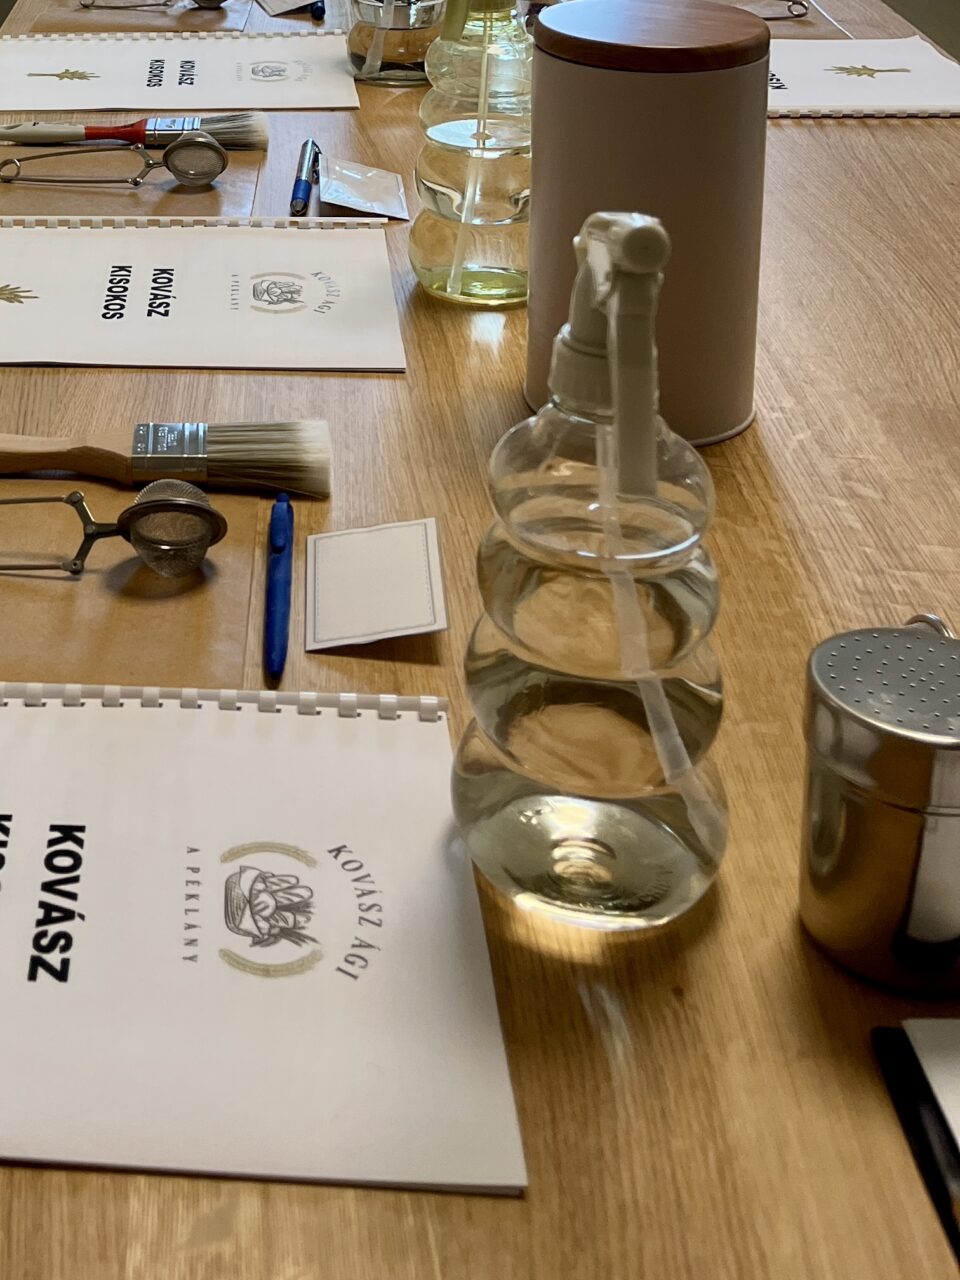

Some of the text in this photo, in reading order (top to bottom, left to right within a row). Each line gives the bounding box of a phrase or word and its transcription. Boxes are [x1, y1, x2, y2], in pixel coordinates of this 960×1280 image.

[101, 265, 133, 320] KISOKOS
[146, 268, 177, 318] KOVÁSZ
[27, 823, 87, 984] KOVÁSZ
[182, 846, 201, 964] A PÉKLÁNY
[327, 844, 383, 982] KOVÁSZ ÁGI
